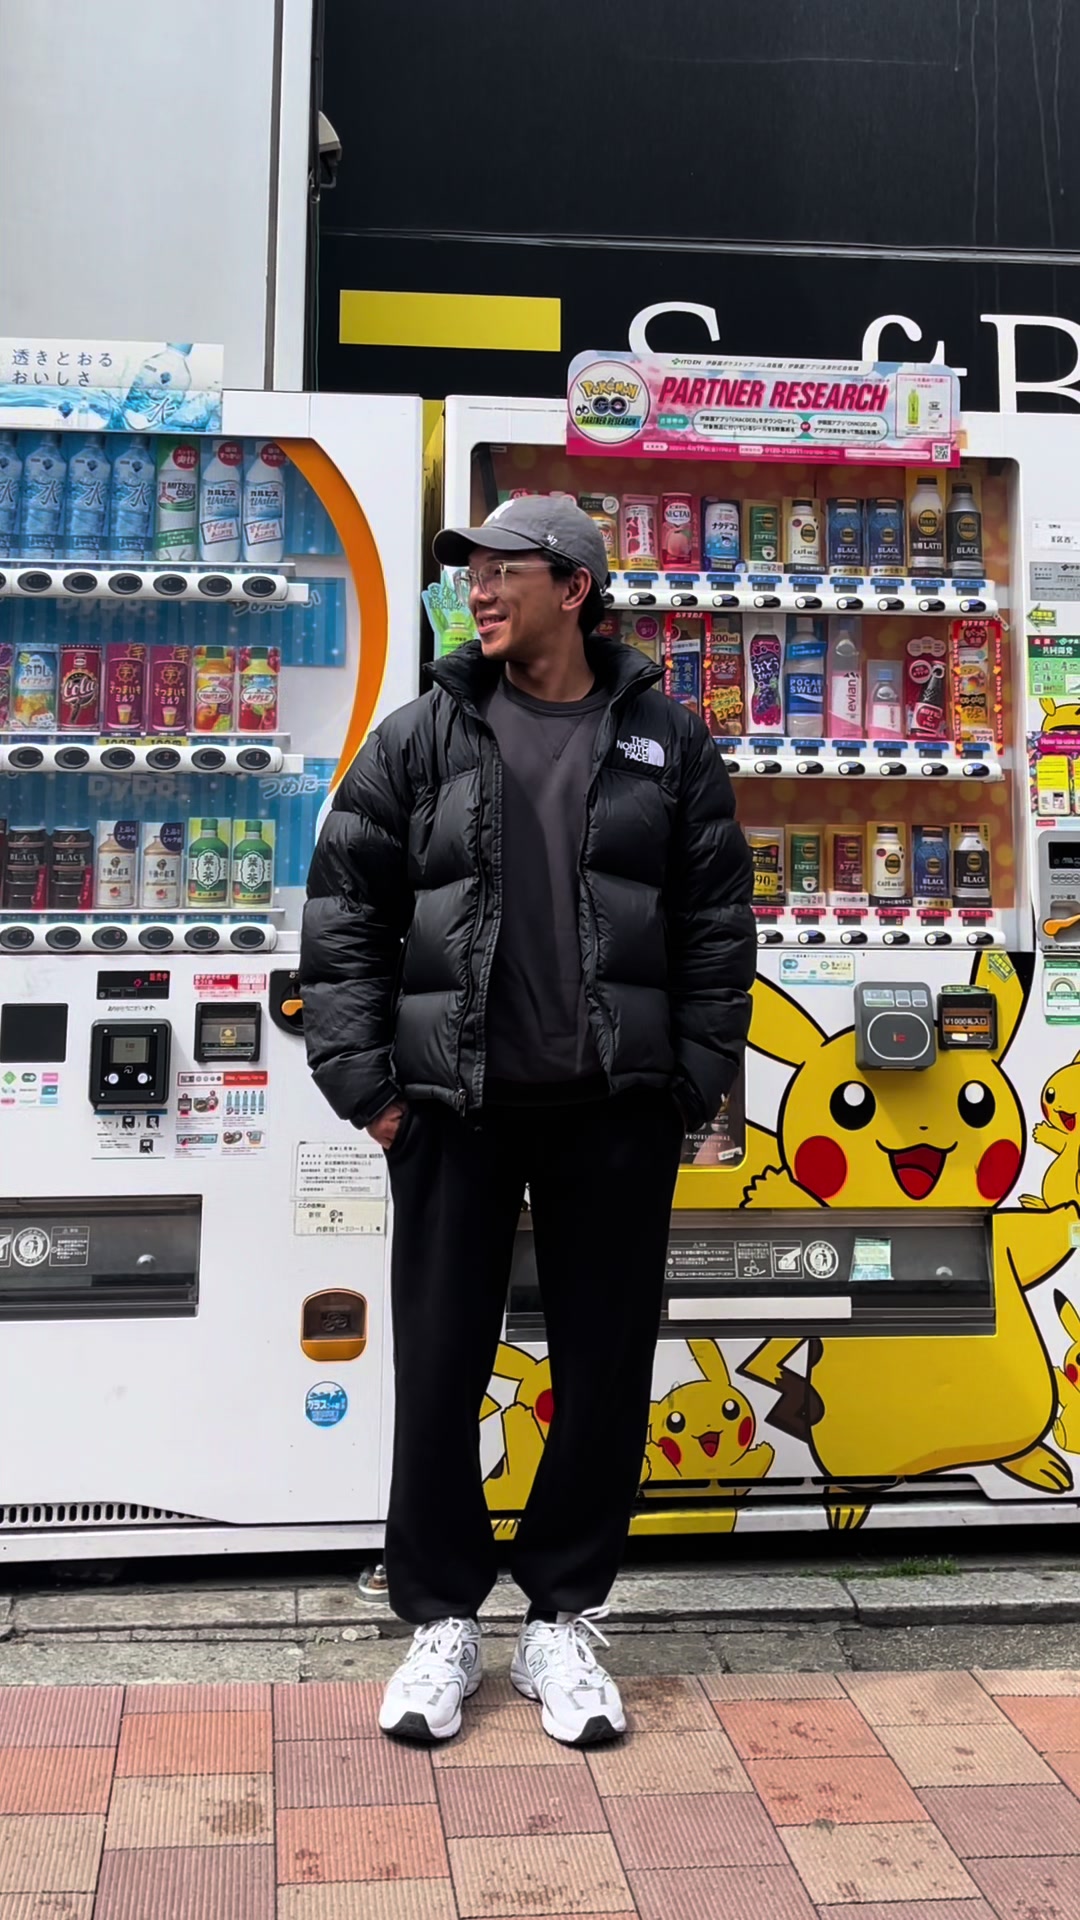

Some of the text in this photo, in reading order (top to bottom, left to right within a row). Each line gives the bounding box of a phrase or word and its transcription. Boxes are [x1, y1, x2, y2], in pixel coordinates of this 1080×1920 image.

[12, 348, 113, 368] 透きとおる
[12, 371, 90, 387] おいしさ
[658, 376, 890, 413] PARTNER RESEARCH
[590, 396, 629, 416] GO
[207, 489, 236, 497] カルピス
[250, 490, 279, 498] カルピス
[753, 657, 779, 674] ぶどう
[63, 676, 95, 701] Cola
[109, 685, 141, 696] さつまいも
[154, 687, 186, 697] さつまいも
[115, 695, 135, 703] ミルク
[160, 696, 180, 705] ミルク
[847, 679, 857, 712] evian
[631, 735, 649, 747] THE
[617, 740, 649, 755] NORTH
[625, 750, 649, 763] FACE
[10, 853, 40, 861] BLACK
[56, 853, 86, 861] BLACK
[962, 875, 985, 883] BLACK
